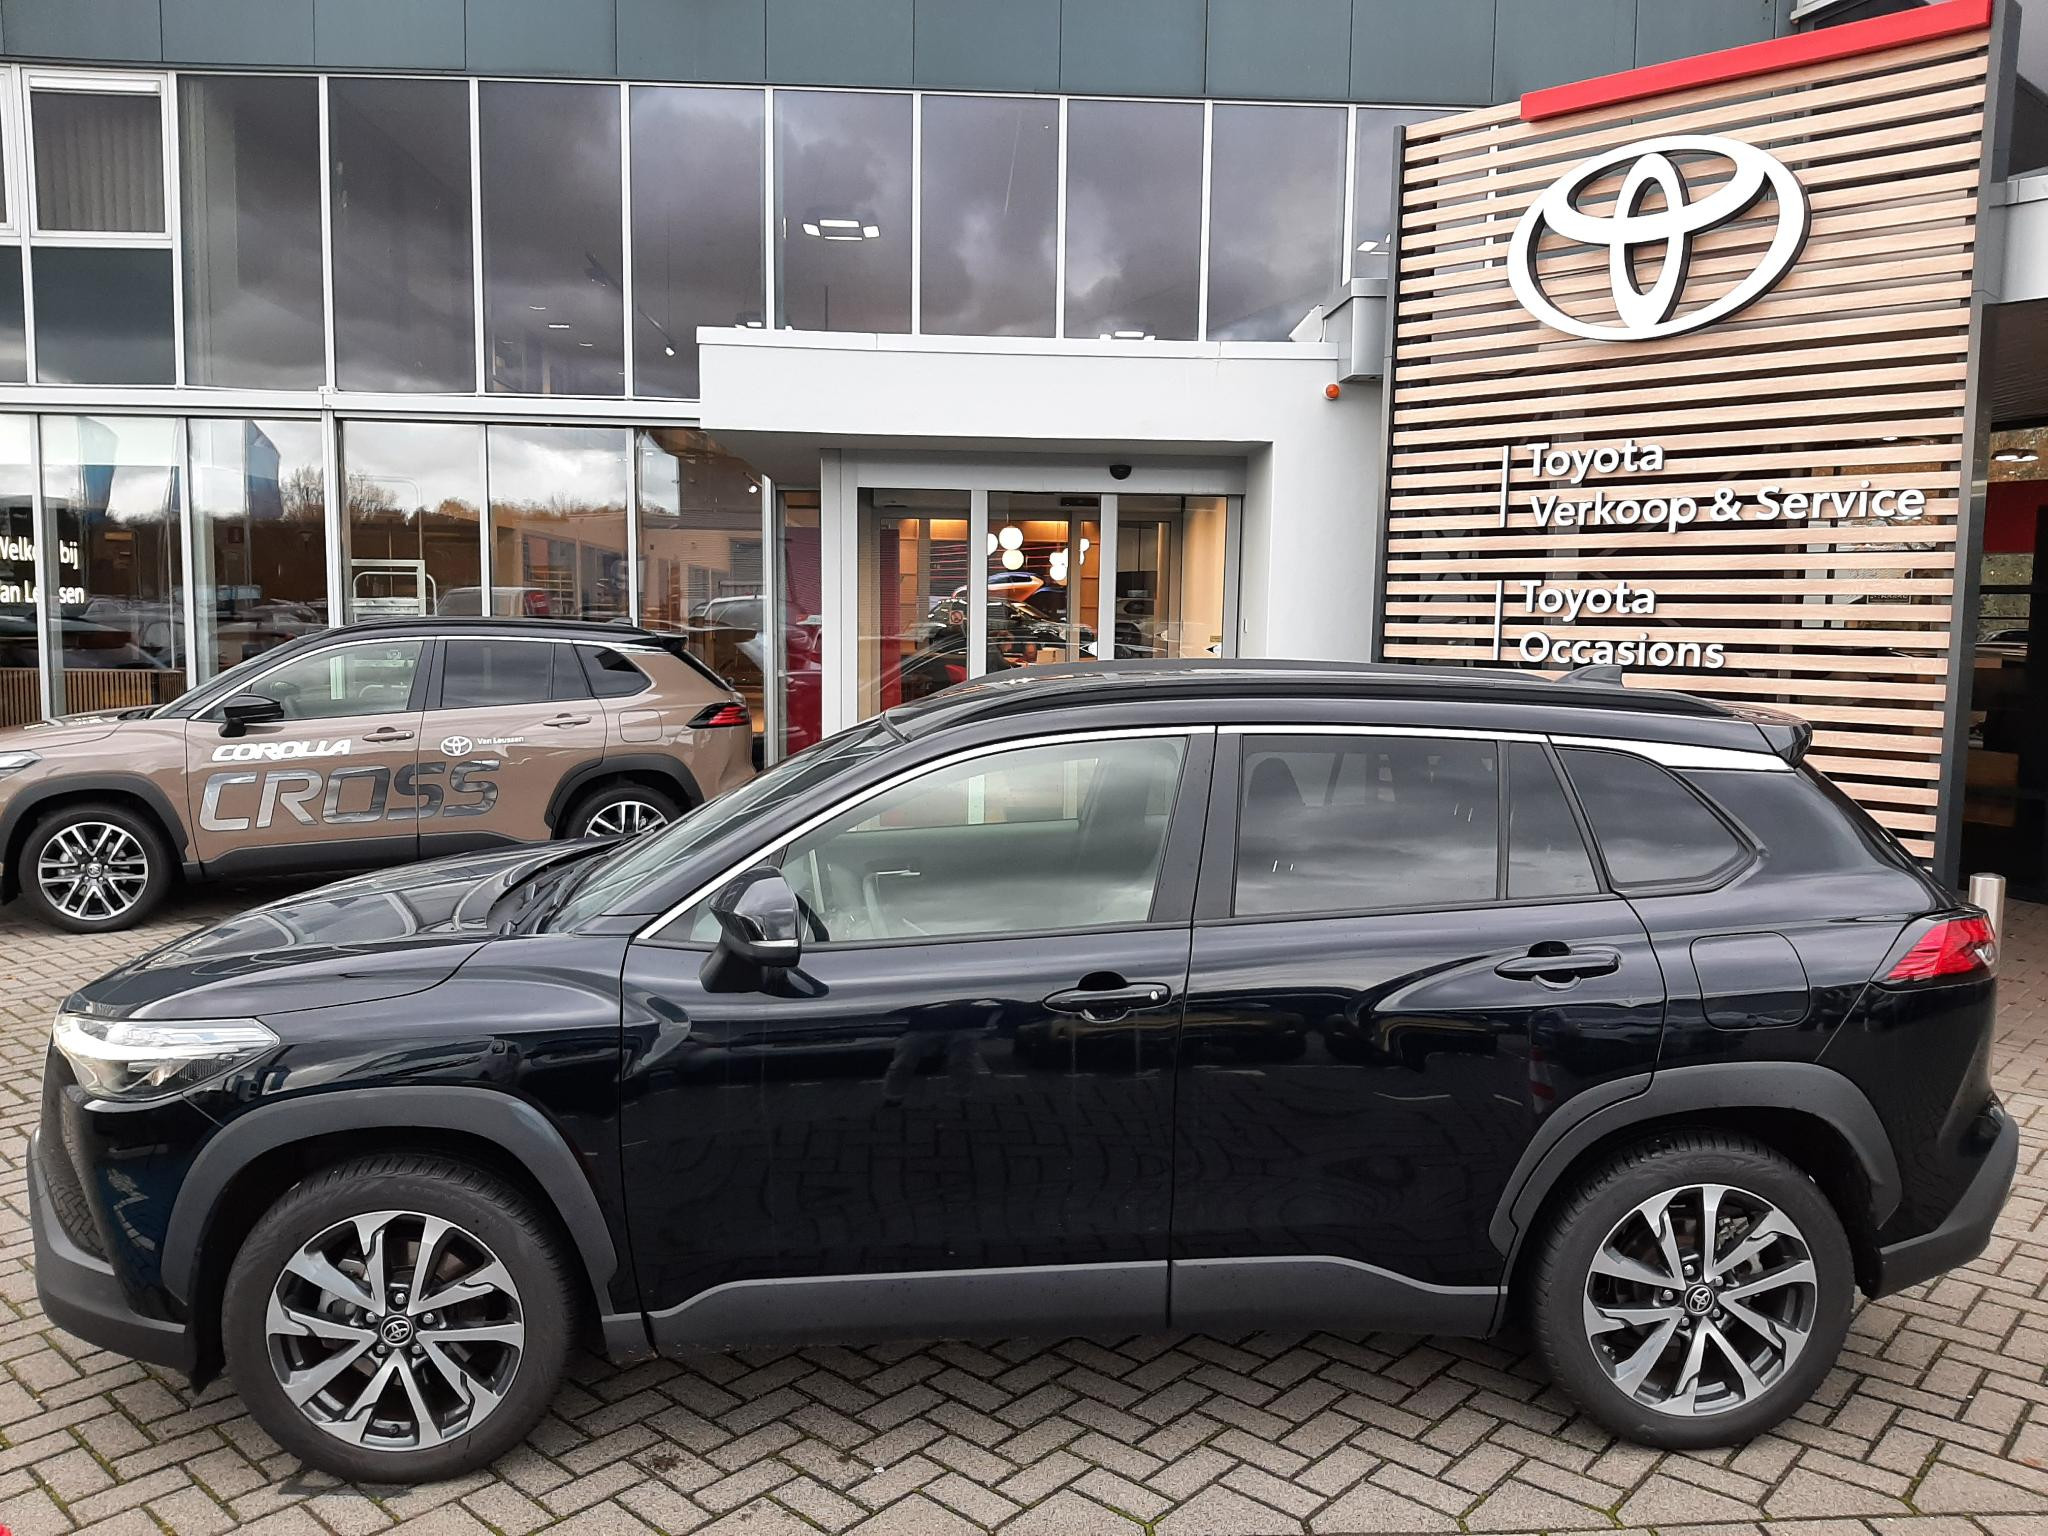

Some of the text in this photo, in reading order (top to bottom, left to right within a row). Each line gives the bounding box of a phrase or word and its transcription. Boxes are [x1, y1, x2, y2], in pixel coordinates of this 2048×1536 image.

[1526, 439, 1664, 485] Toyota
[1530, 479, 1926, 534] Verkoop & Service
[60, 539, 79, 570] bij
[0, 584, 21, 603] an
[1519, 579, 1656, 622] Toyota
[1519, 631, 1726, 669] Occasions
[211, 739, 352, 762] COROLLA
[476, 737, 493, 745] Van
[199, 760, 500, 832] CROSS
